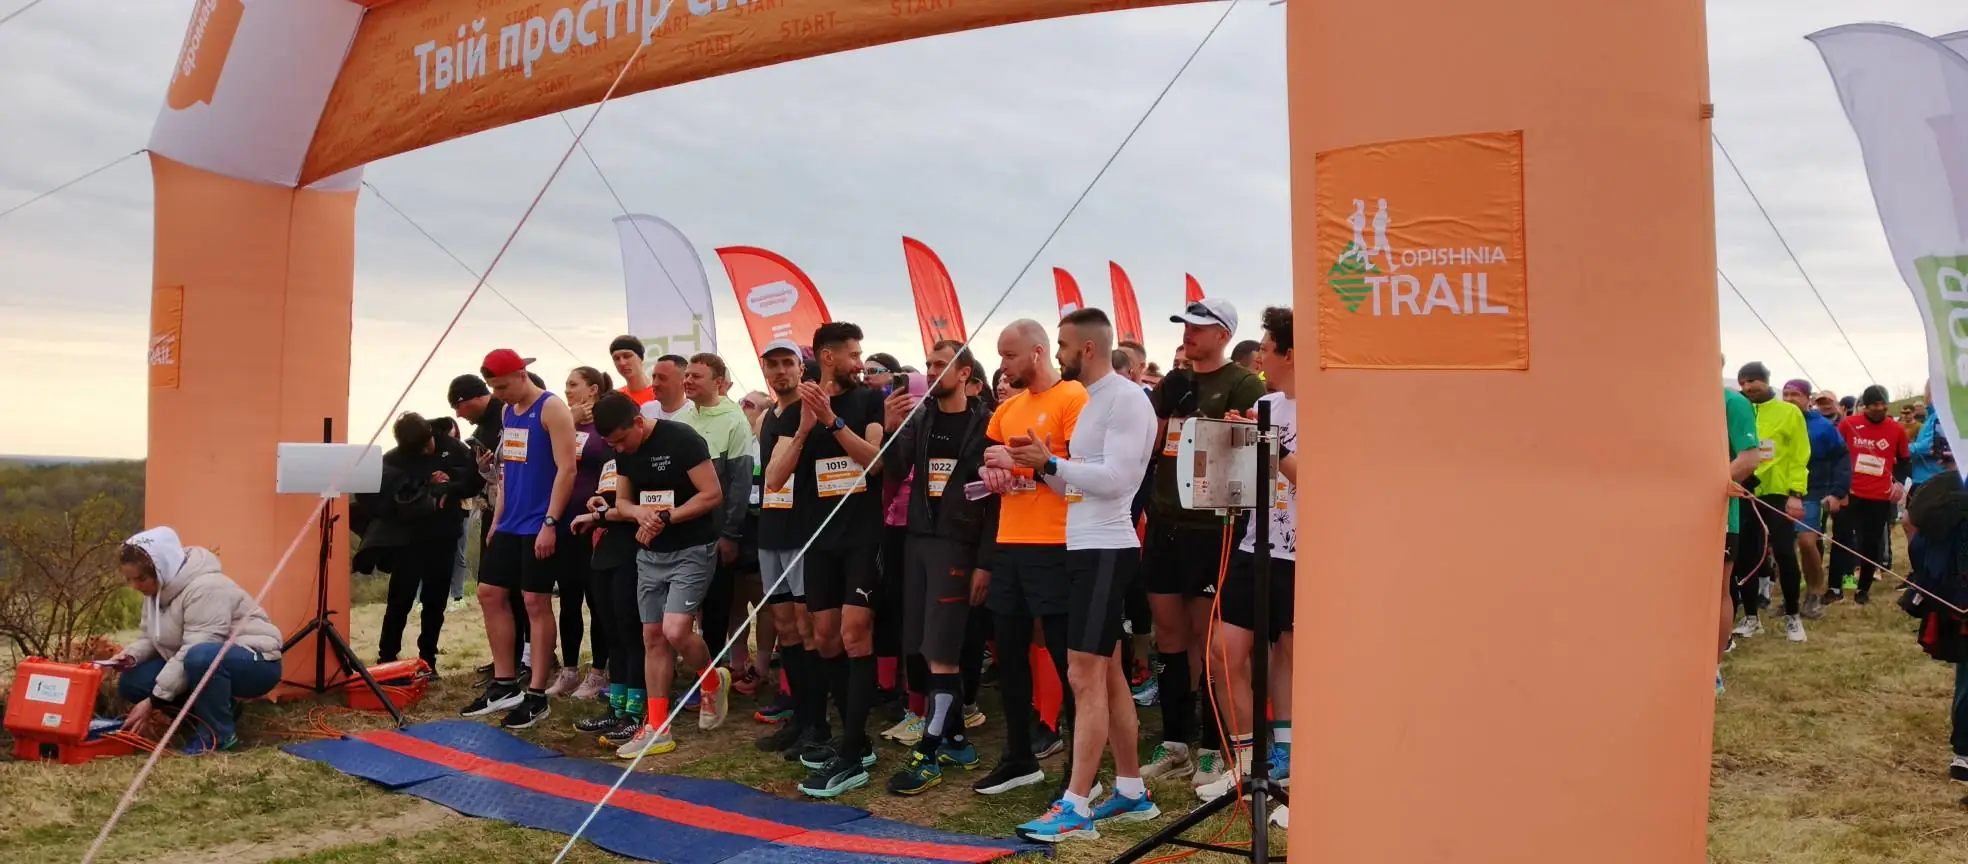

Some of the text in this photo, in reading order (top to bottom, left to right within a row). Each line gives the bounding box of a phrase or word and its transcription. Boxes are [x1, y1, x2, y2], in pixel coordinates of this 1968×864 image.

[780, 10, 837, 38] START
[414, 0, 669, 96] Твій простір
[686, 34, 735, 58] START
[536, 73, 575, 98] START
[1401, 246, 1507, 267] OPISHNIA
[1364, 272, 1509, 316] TRAIL
[825, 460, 849, 471] 1019
[930, 462, 952, 472] 1022
